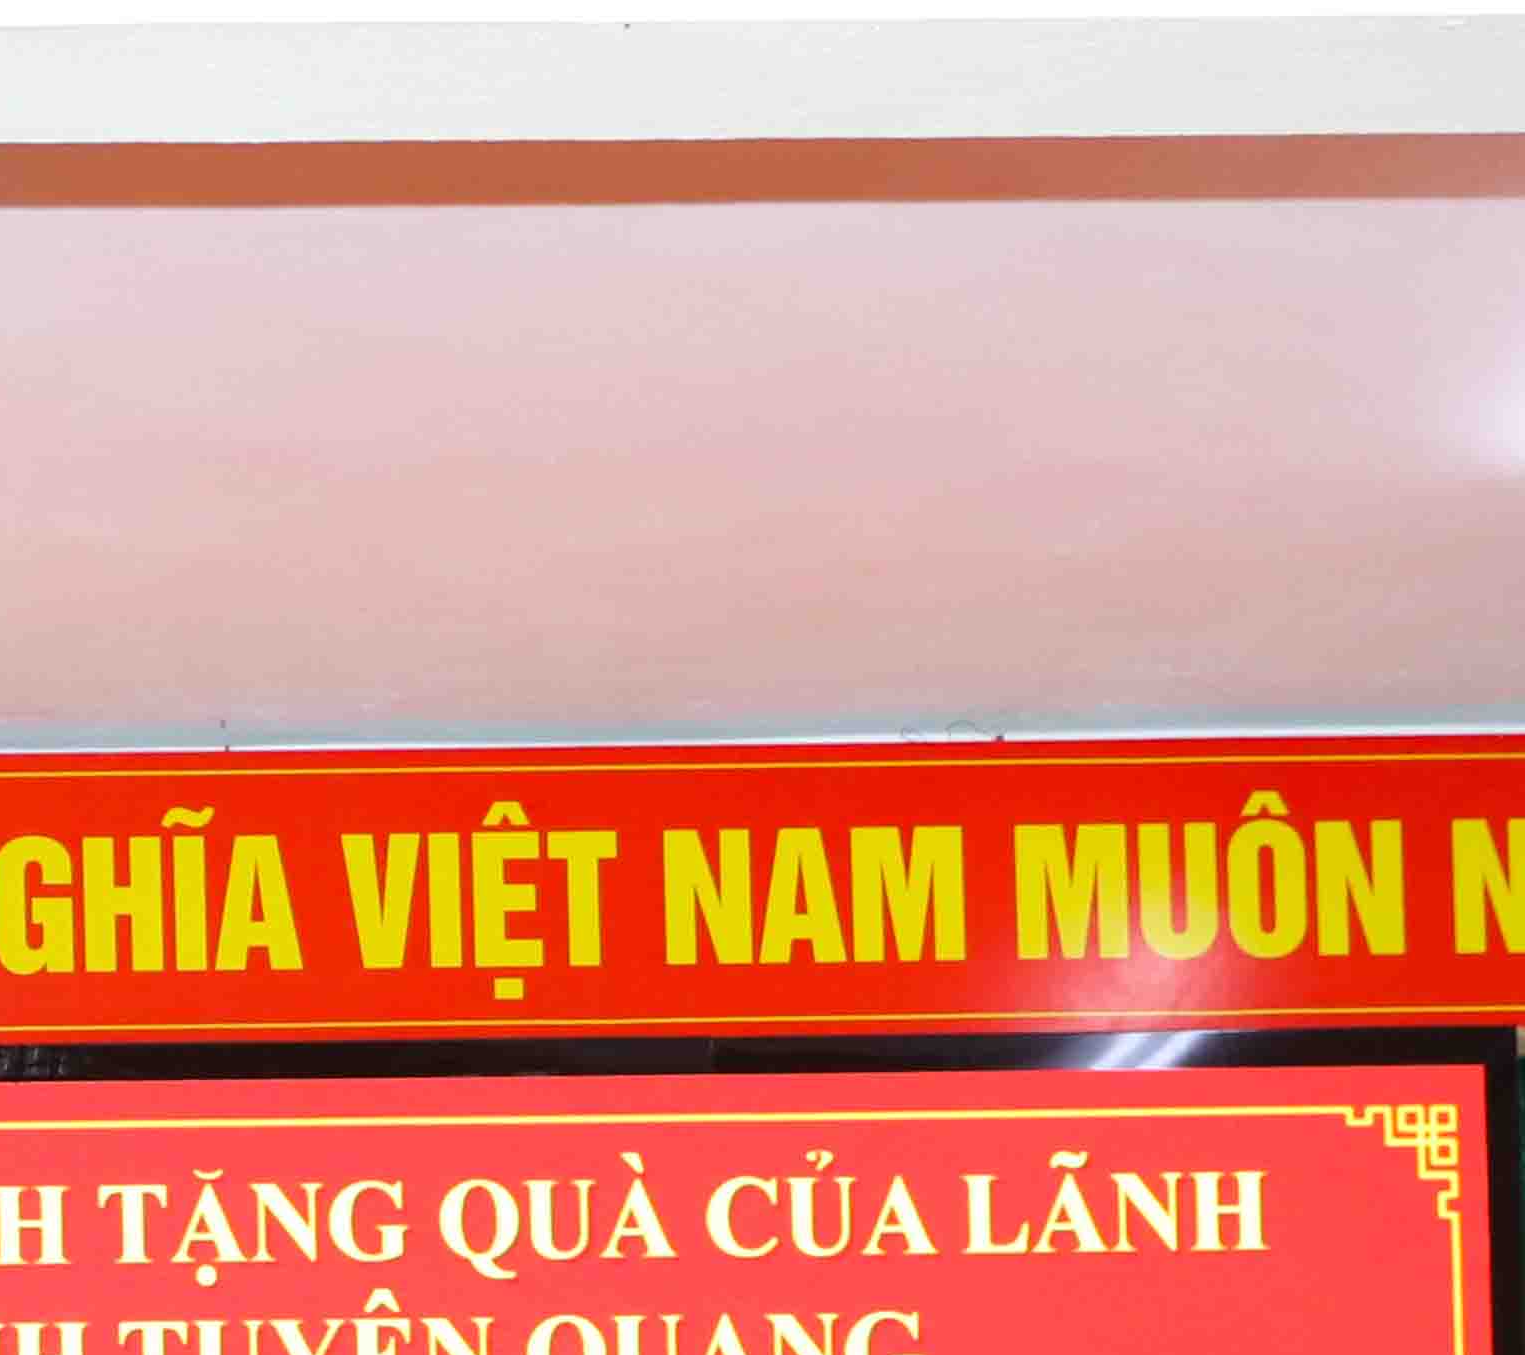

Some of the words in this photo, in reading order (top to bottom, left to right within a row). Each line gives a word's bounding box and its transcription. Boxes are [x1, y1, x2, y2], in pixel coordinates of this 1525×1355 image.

[342, 801, 617, 999] VIỆT
[663, 826, 966, 965] NAM
[1018, 791, 1406, 960] MUÔN
[98, 1169, 407, 1286] TẶNG
[439, 1152, 676, 1279] QUÀ
[706, 1150, 938, 1257] CỦA
[963, 1151, 1268, 1254] LÃNH
